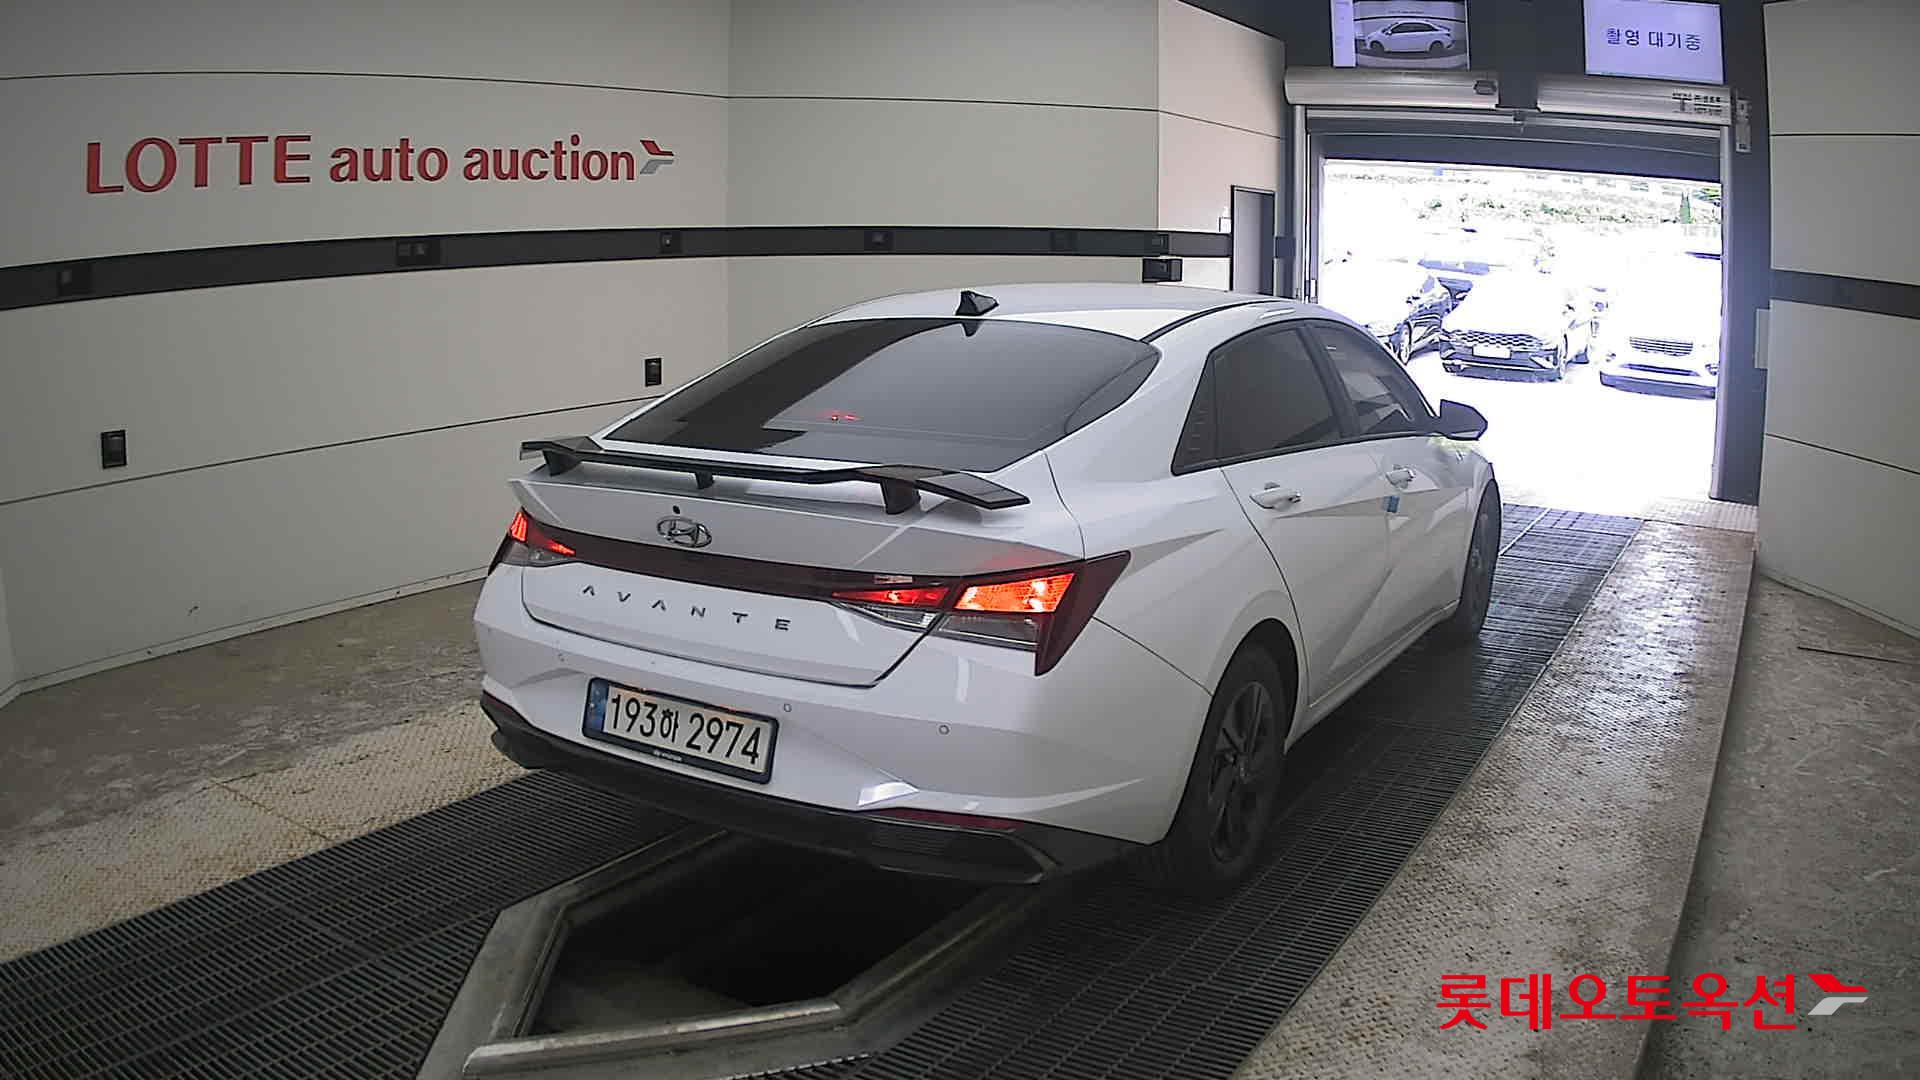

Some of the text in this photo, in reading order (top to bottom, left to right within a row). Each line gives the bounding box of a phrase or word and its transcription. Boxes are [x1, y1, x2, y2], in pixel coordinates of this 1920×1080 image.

[1648, 31, 1701, 51] 대기중
[86, 134, 636, 194] LOTTE auto auction
[582, 584, 792, 632] AVANTE
[611, 693, 761, 765] 193하 2974
